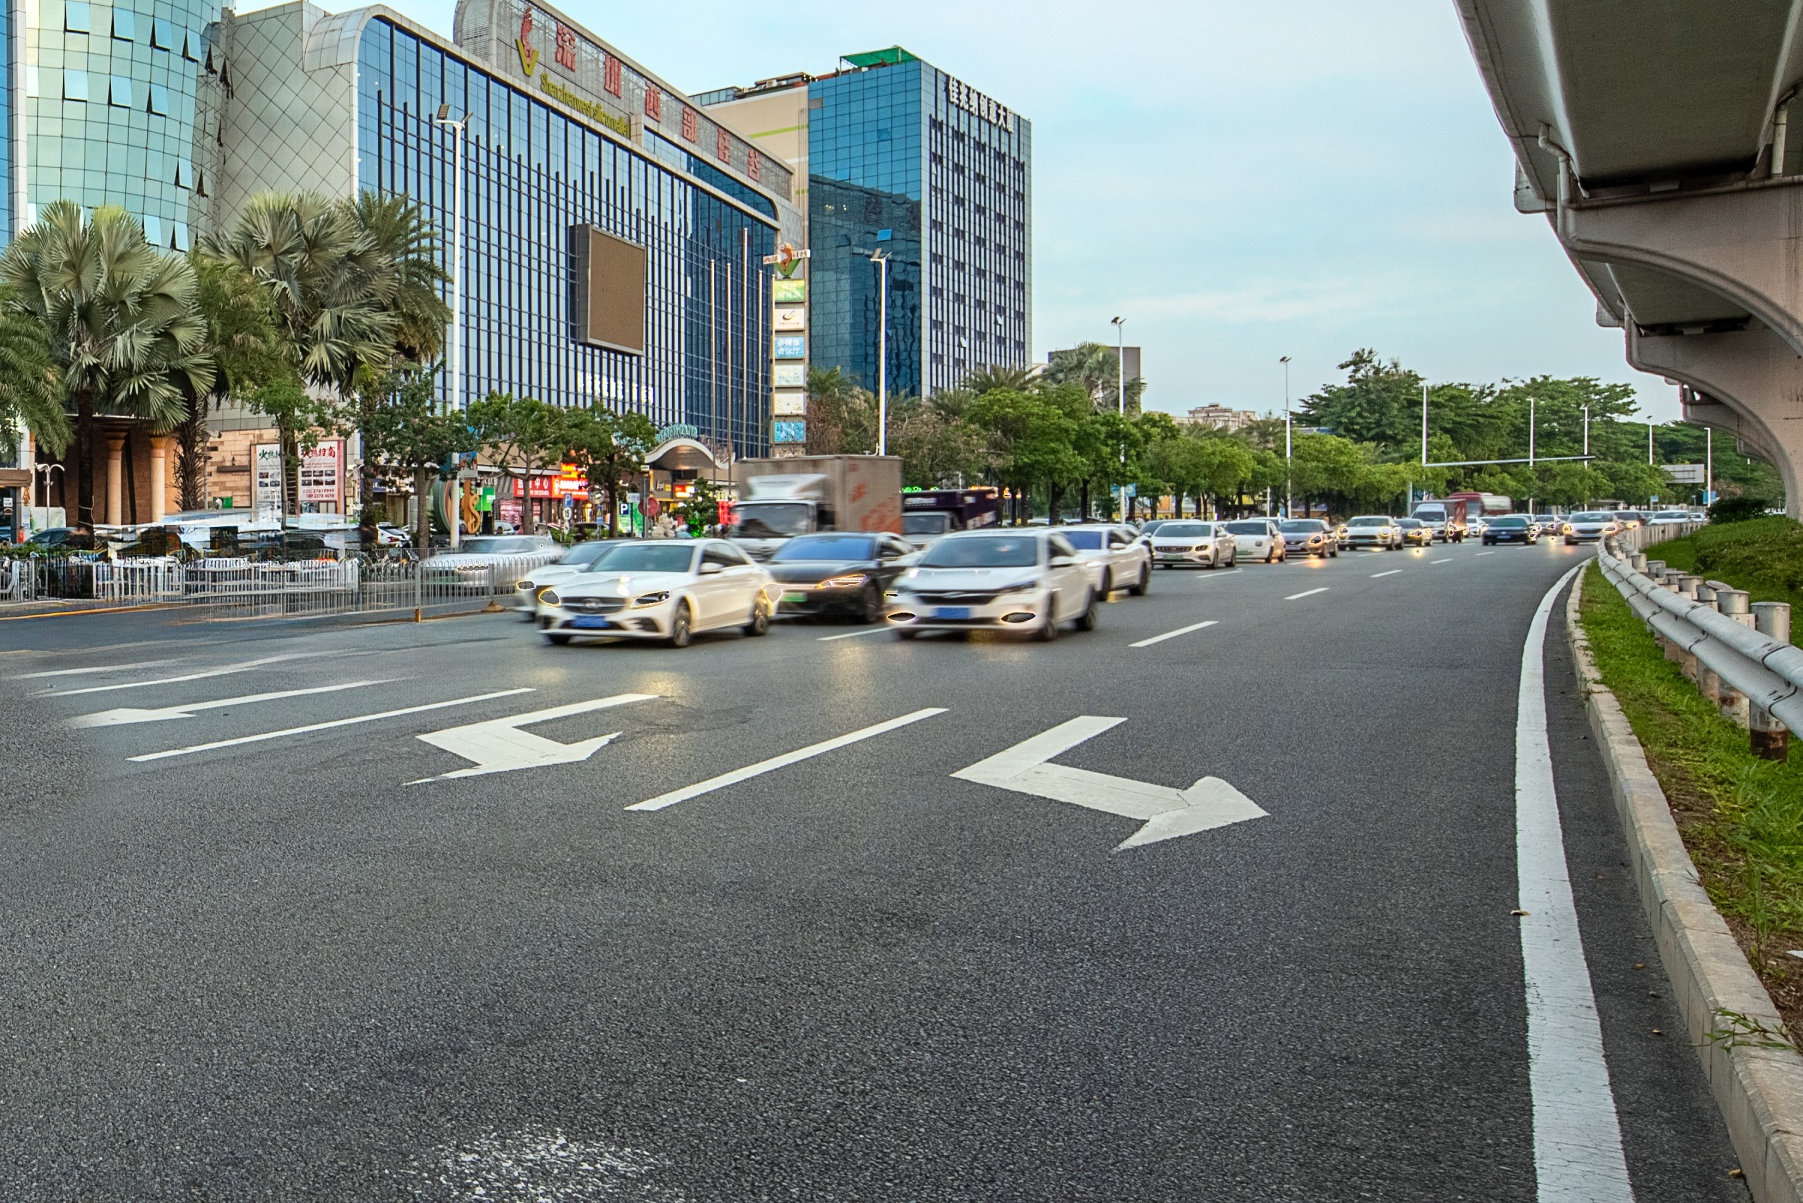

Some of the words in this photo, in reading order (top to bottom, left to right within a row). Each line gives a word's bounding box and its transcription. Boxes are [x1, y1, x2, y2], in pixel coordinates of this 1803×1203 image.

[555, 20, 760, 183] 深圳西部硅谷
[620, 503, 628, 515] P
